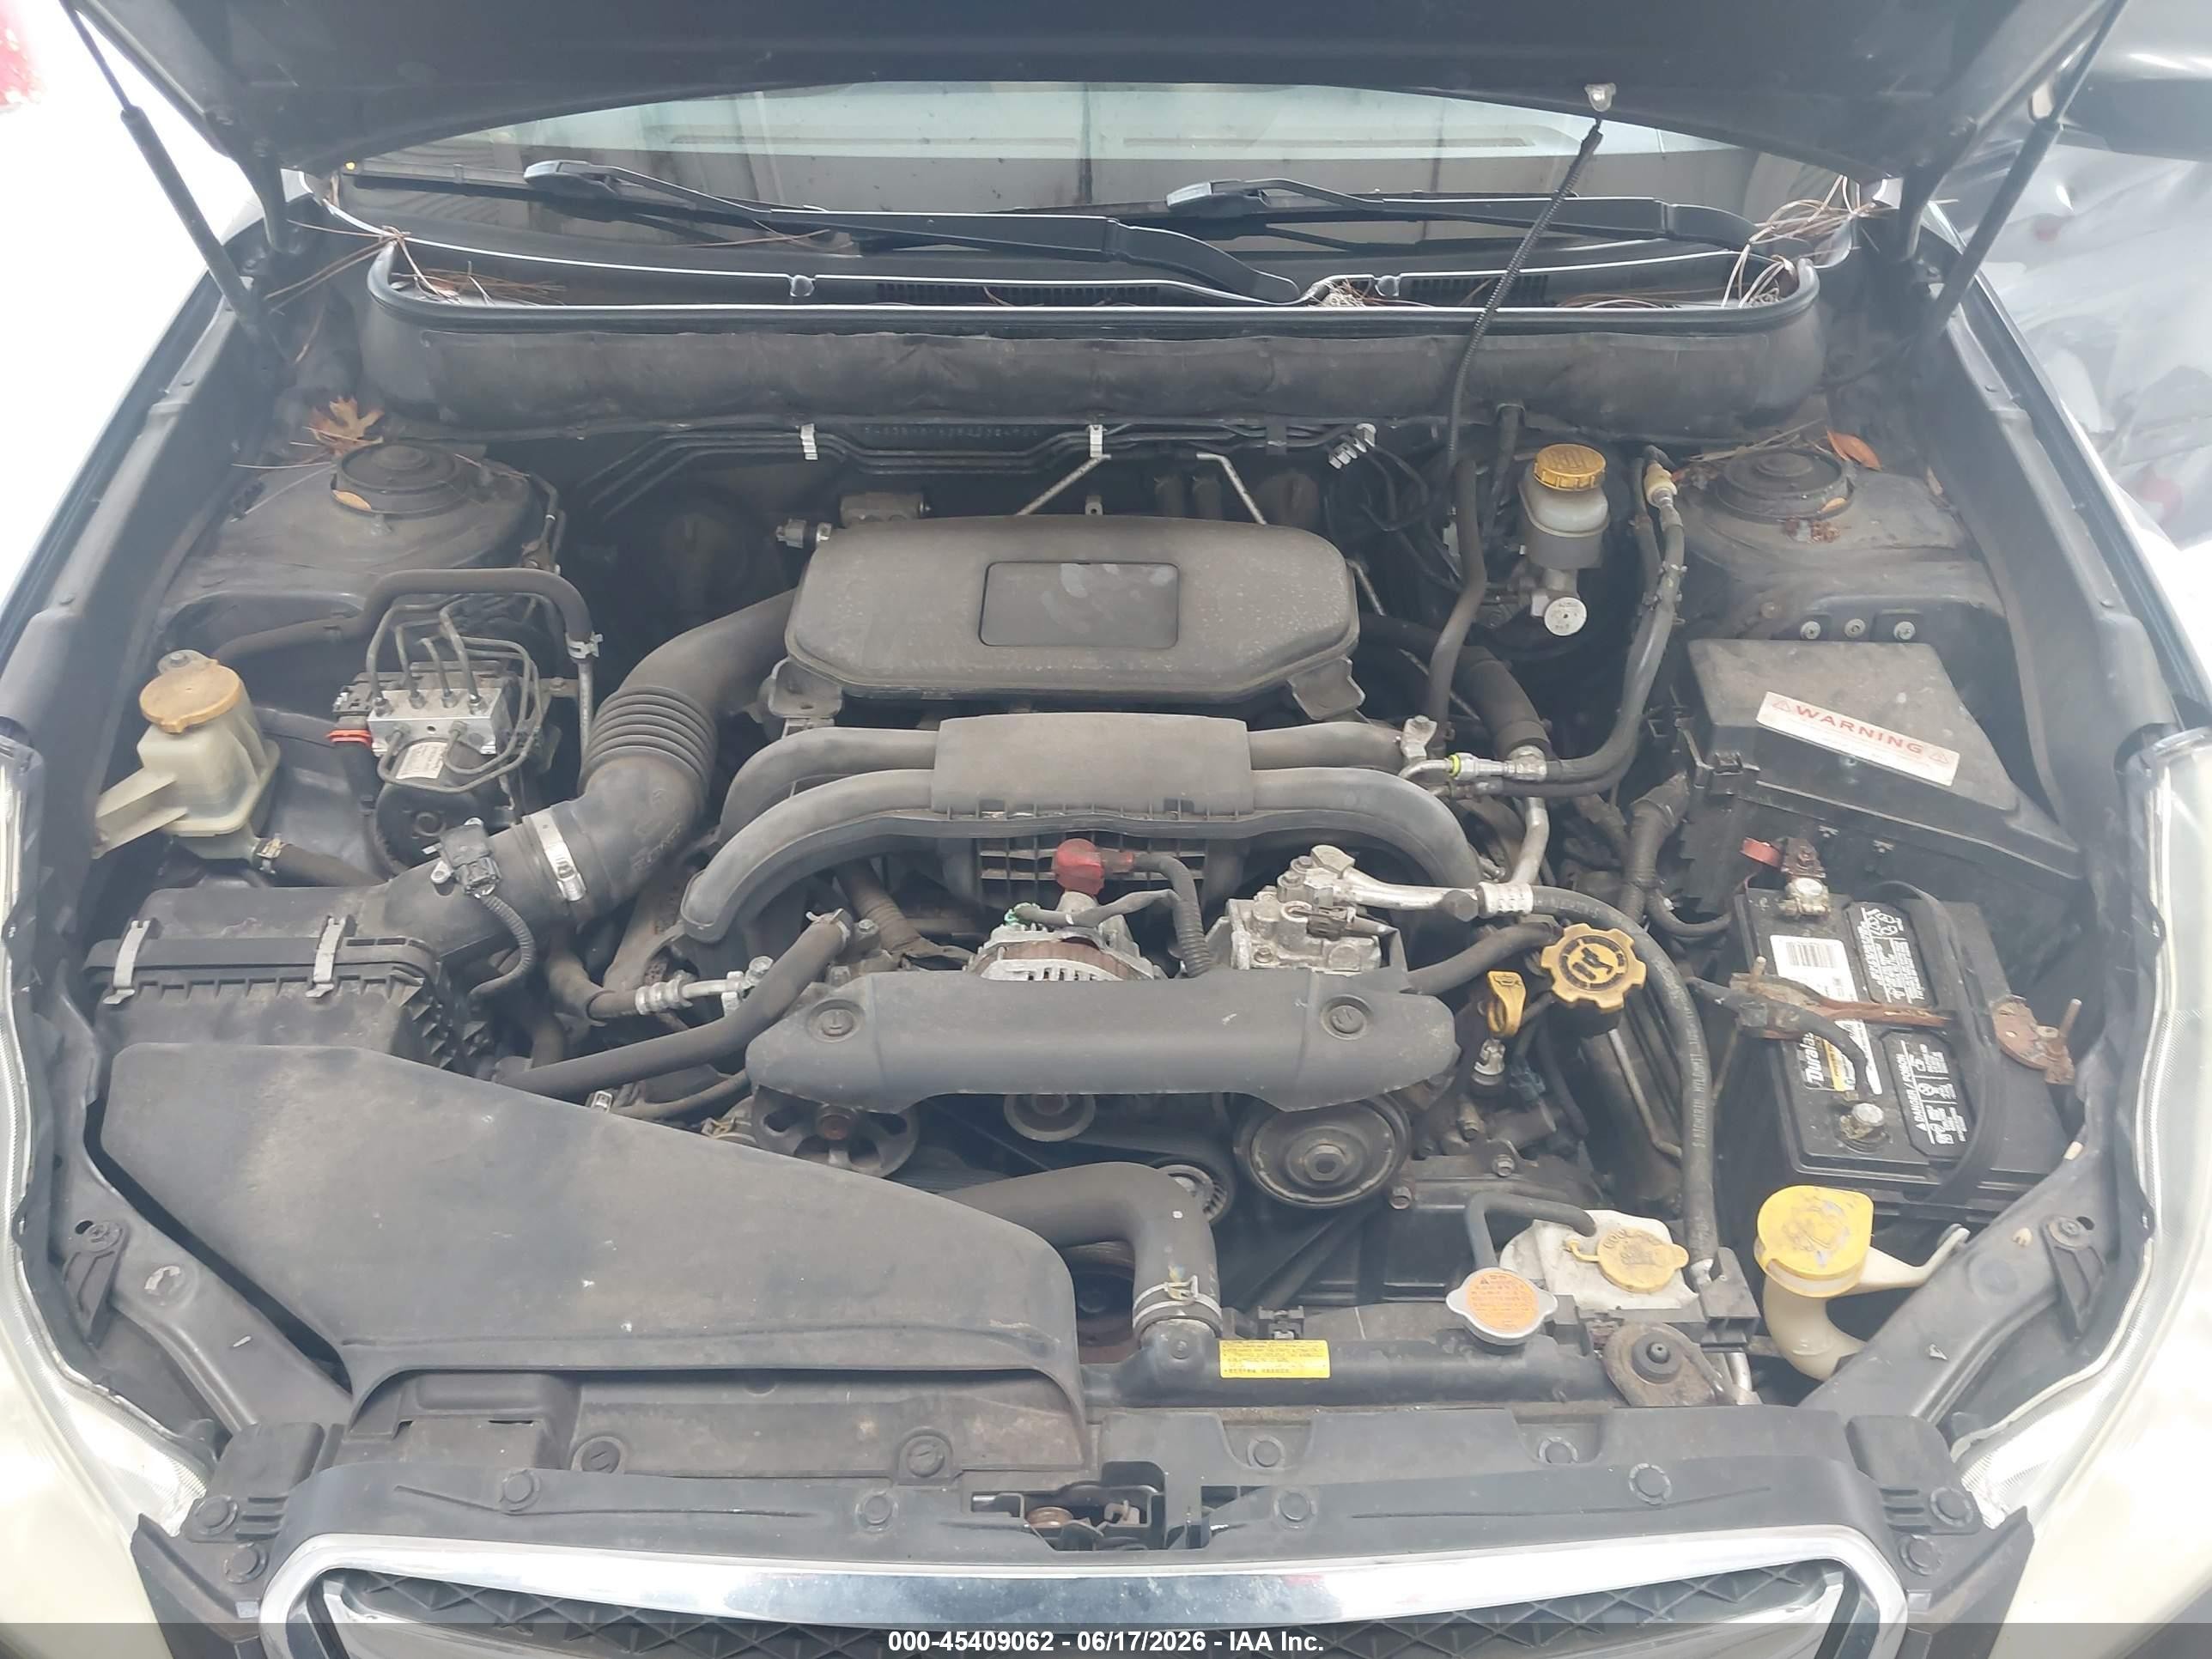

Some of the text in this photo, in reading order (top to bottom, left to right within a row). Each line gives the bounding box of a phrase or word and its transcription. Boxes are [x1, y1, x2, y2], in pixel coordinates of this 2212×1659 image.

[1795, 705, 1925, 755] WARNING
[1895, 1054, 1911, 1083] POISON
[1905, 1088, 1923, 1122] DANGER
